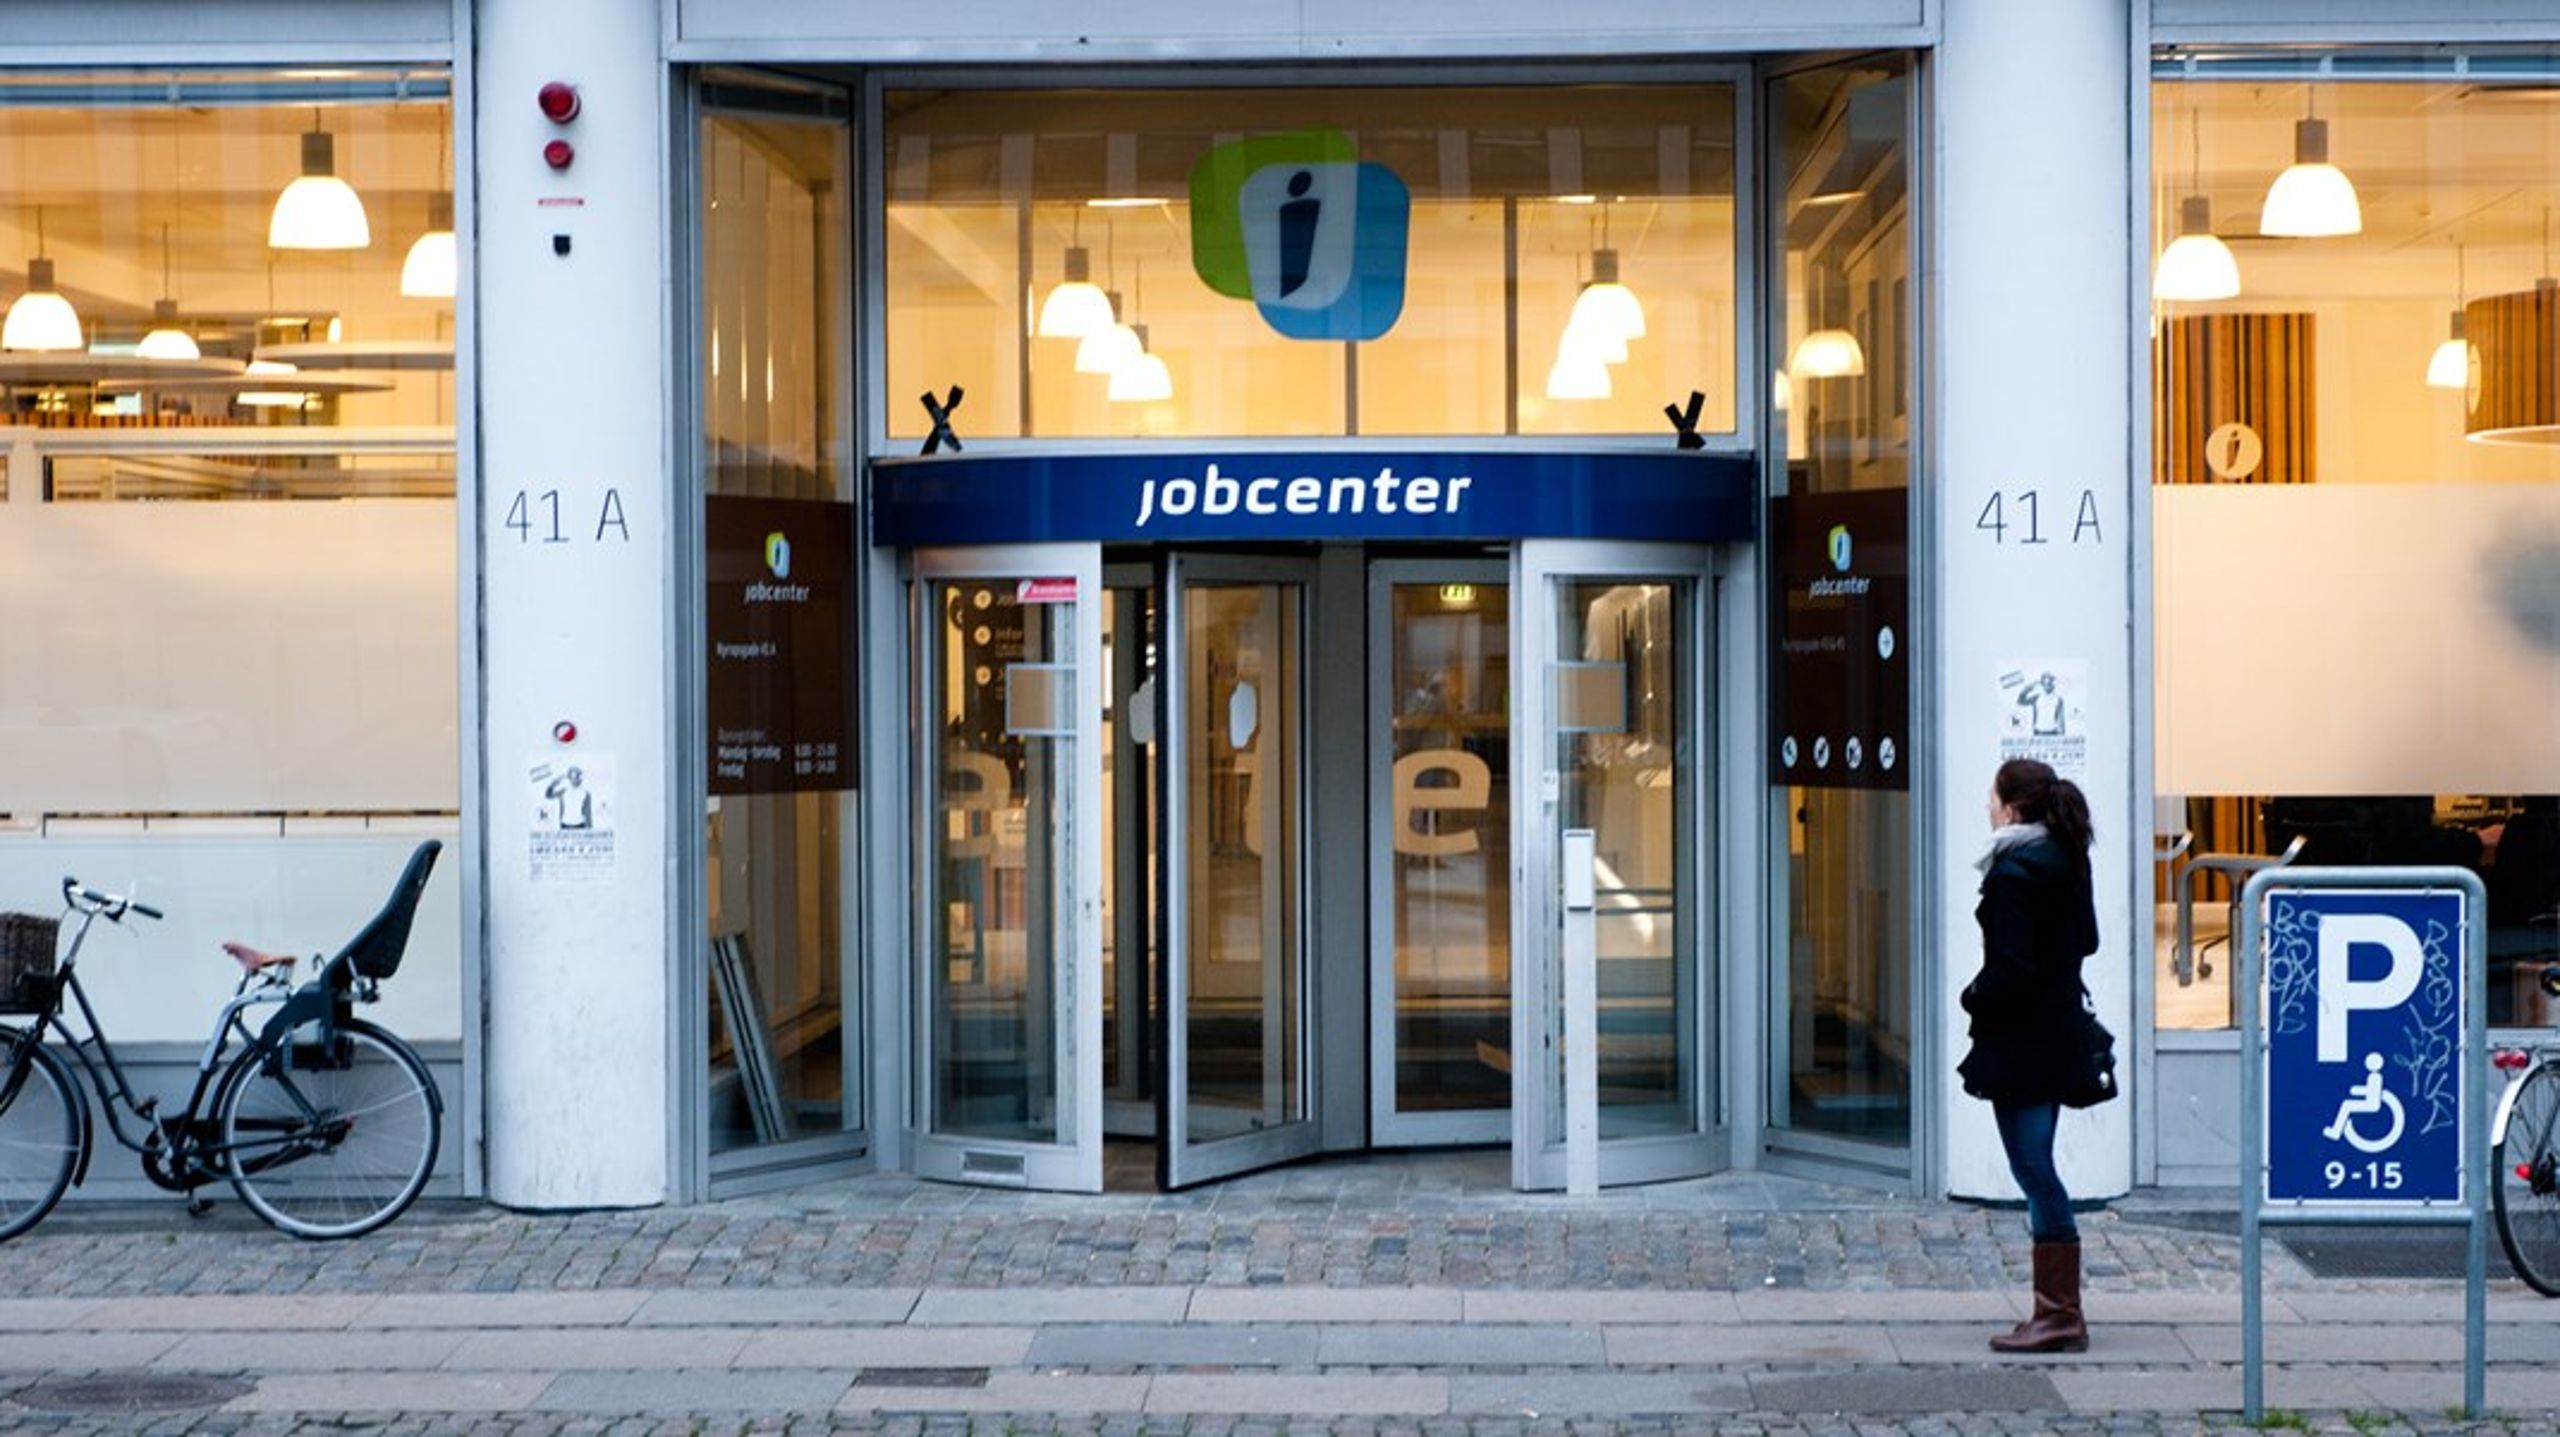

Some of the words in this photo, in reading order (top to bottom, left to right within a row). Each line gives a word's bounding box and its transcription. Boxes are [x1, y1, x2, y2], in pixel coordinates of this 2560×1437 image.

[505, 489, 570, 542] 41
[596, 488, 629, 542] A
[1135, 463, 1473, 528] jobcenter
[1976, 490, 2047, 542] 41
[2073, 489, 2102, 542] A
[743, 580, 810, 606] jobcenter
[1808, 575, 1871, 600] jobcenter
[2318, 914, 2424, 1063] P
